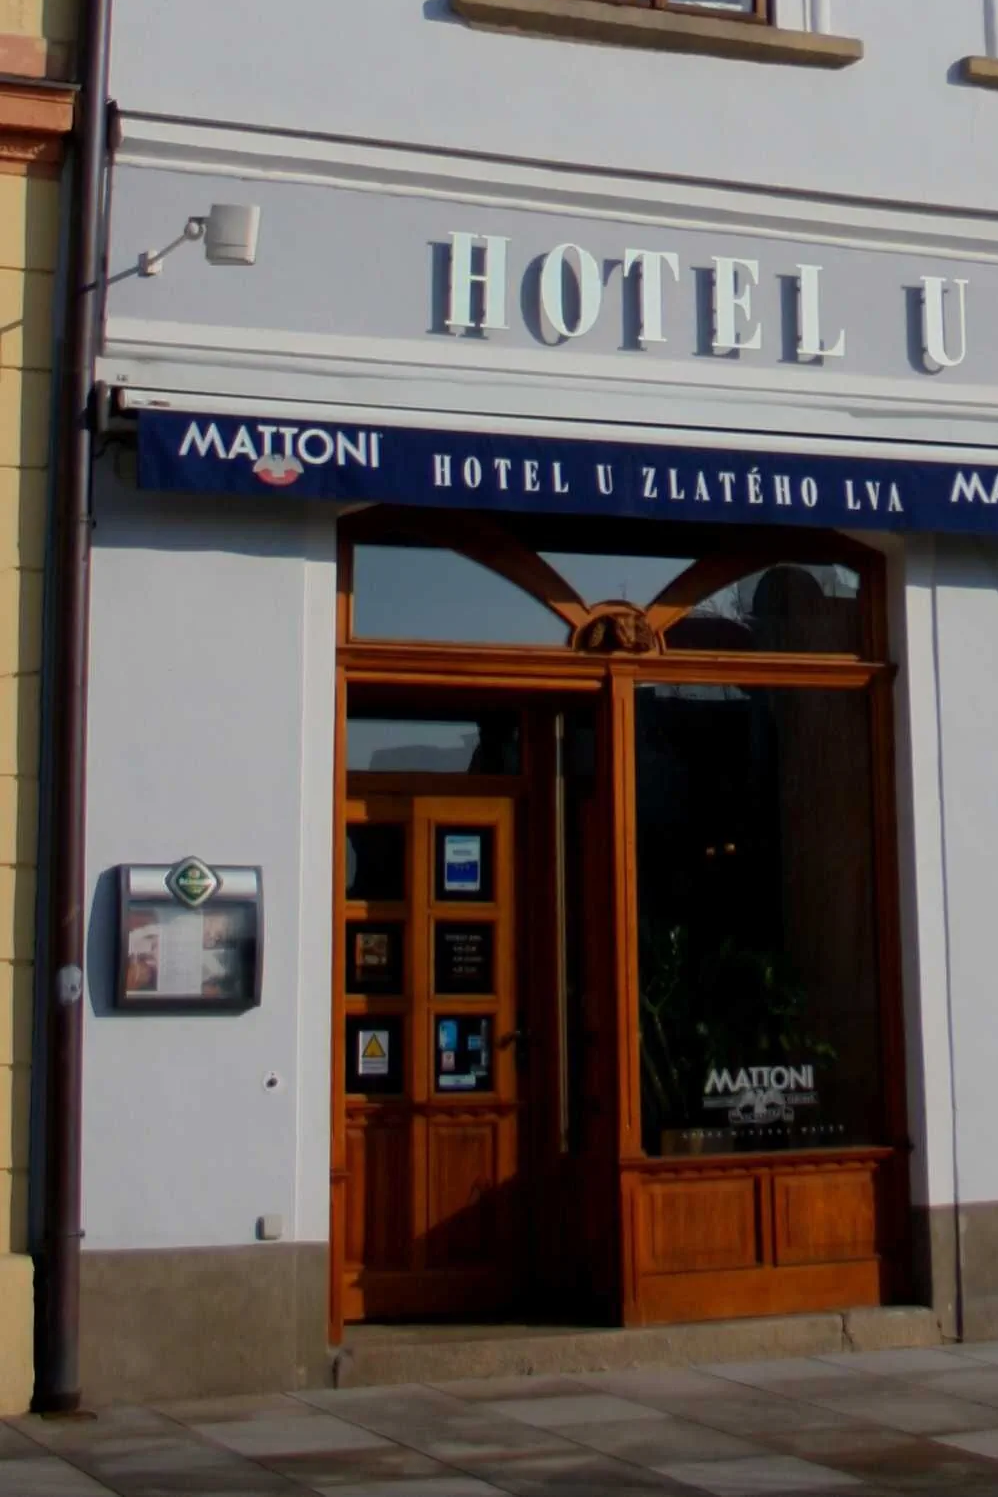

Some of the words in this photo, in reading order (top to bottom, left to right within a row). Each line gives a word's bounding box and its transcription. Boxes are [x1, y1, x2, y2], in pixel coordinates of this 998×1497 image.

[446, 230, 846, 358] HOTEL
[919, 275, 970, 367] U
[179, 421, 381, 470] MATTONI
[433, 453, 570, 495] HOTEL
[595, 463, 615, 497] U
[641, 466, 819, 509] ZLATÉHO
[845, 479, 905, 514] LVA
[704, 1064, 814, 1094] MATTONI
